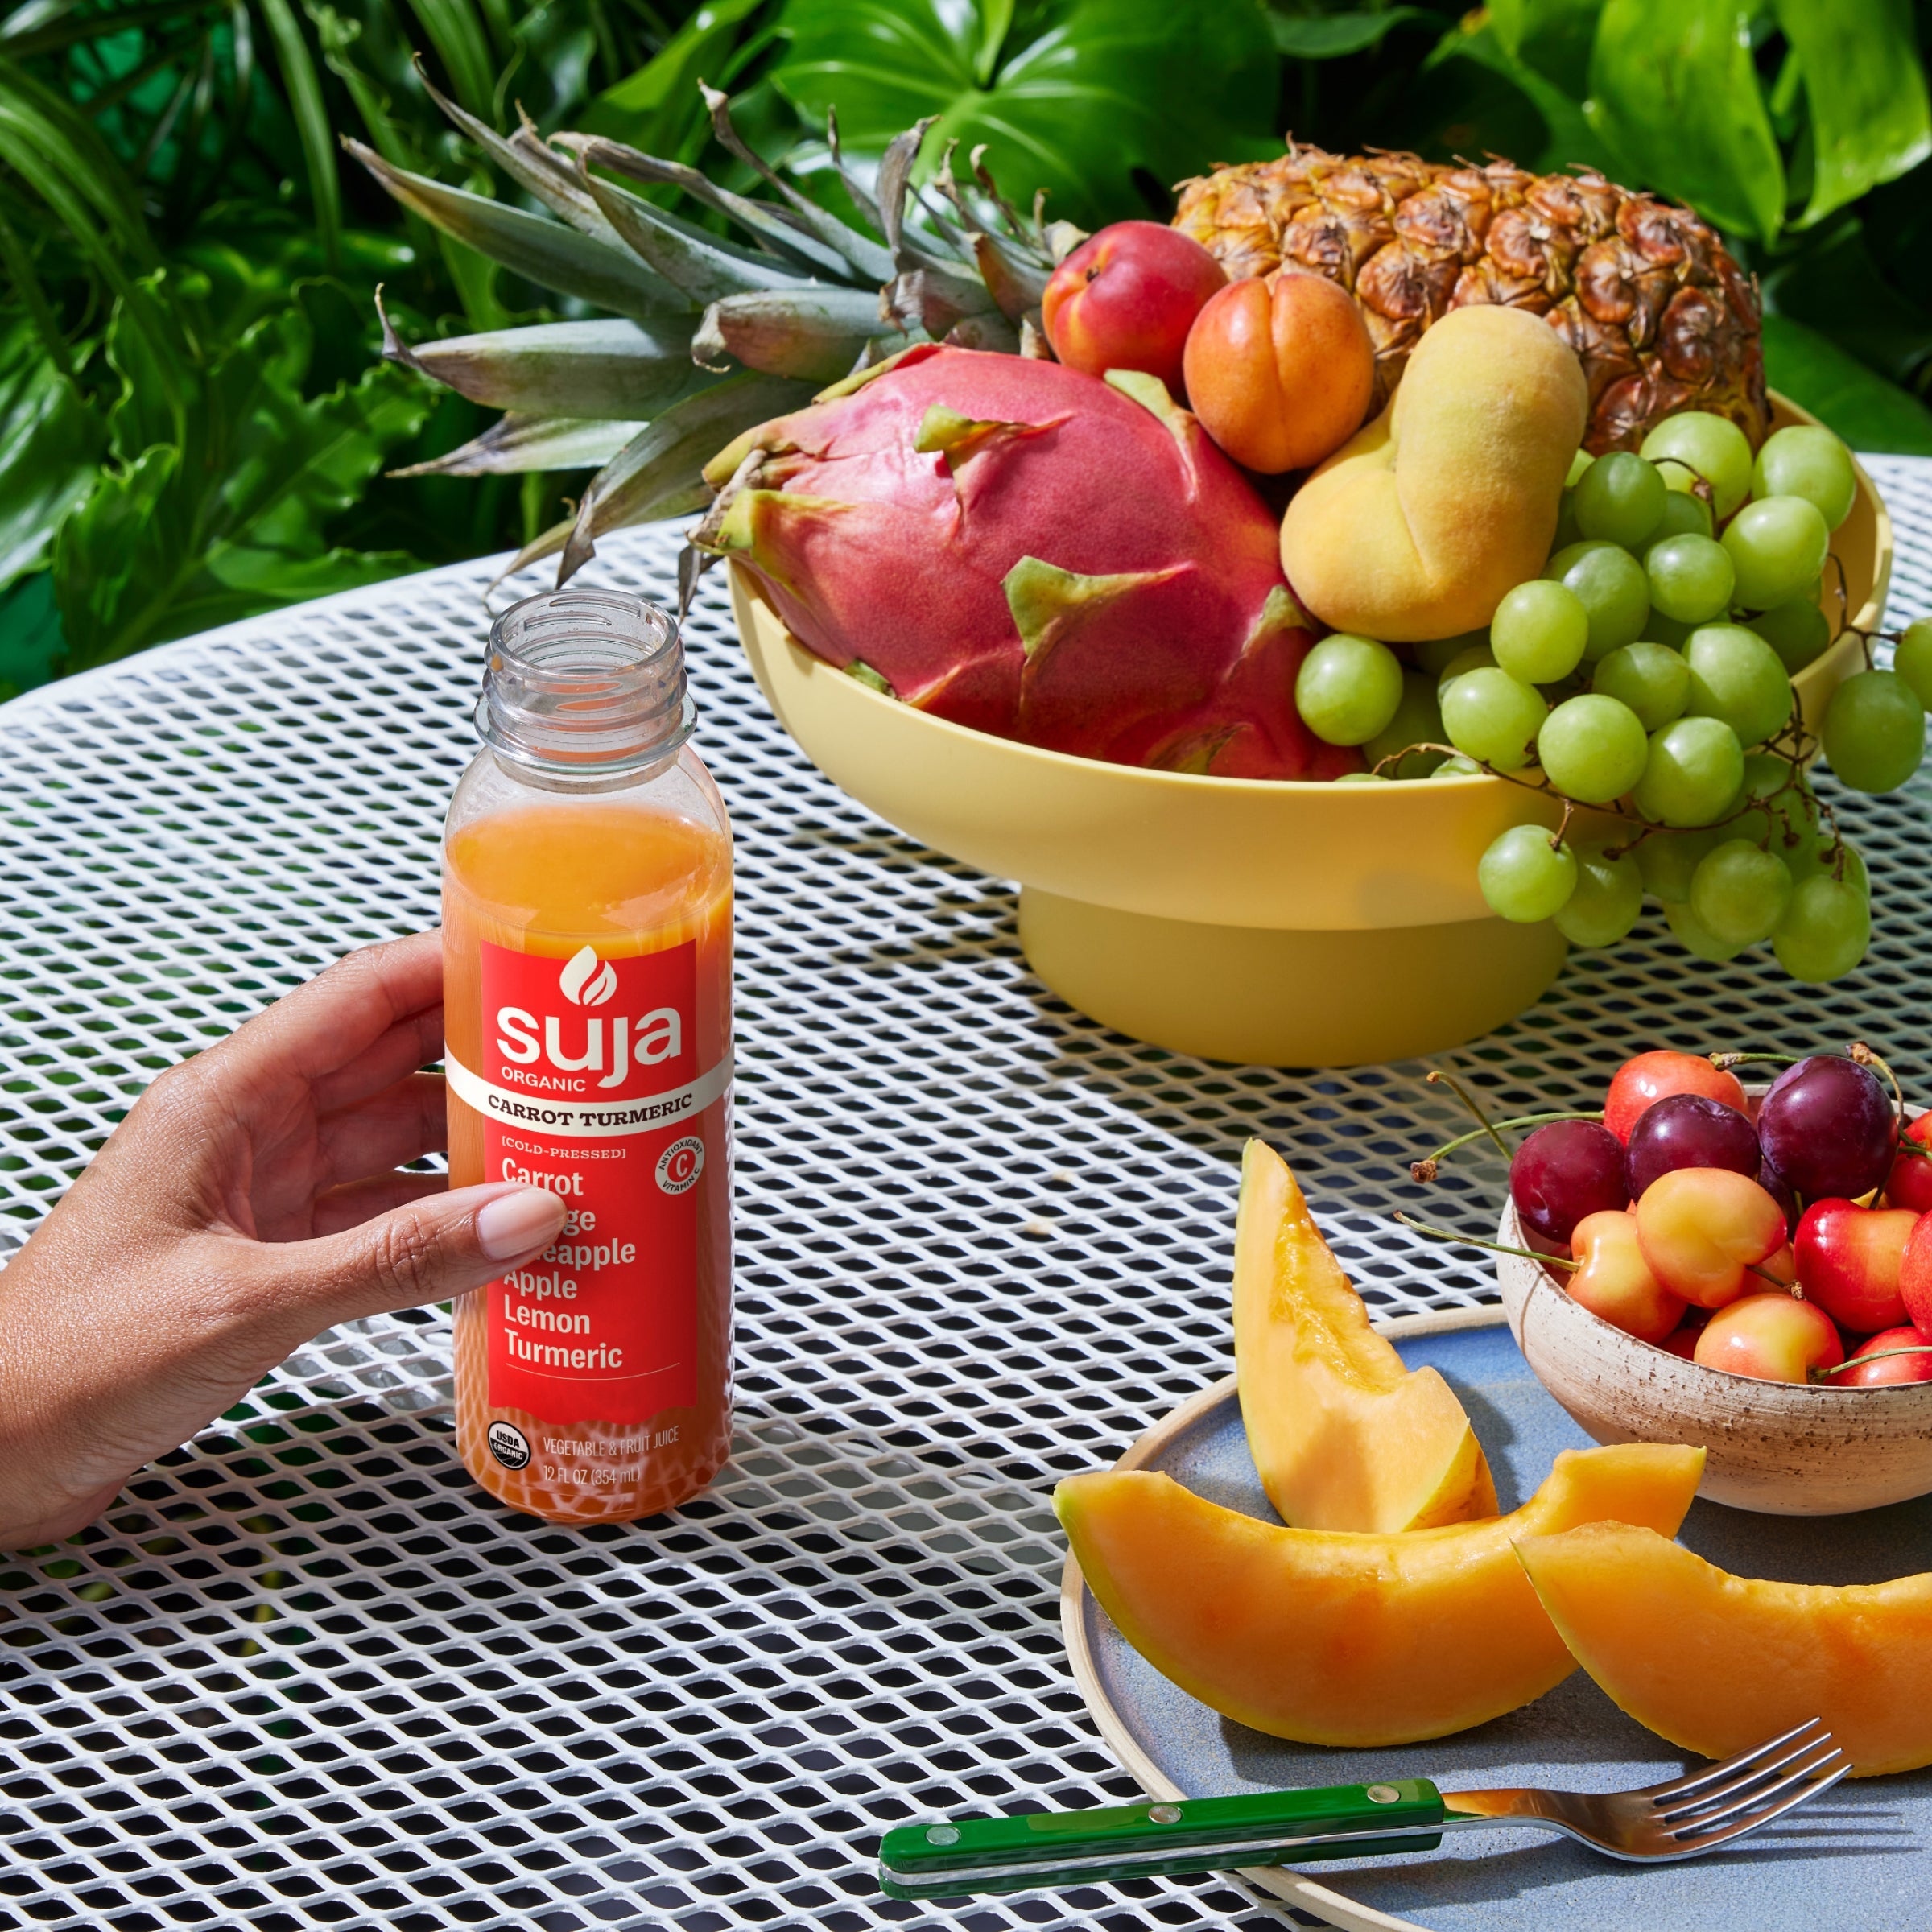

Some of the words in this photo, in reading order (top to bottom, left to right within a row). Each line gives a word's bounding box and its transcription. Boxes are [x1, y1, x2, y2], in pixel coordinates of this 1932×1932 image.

[497, 1006, 681, 1088] suja
[502, 1066, 586, 1092] ORGANIC
[488, 1095, 573, 1126] CARROT
[580, 1093, 692, 1127] TURMERIC
[502, 1136, 626, 1159] [COLD-PRESSED]
[658, 1138, 704, 1170] ANTIOXIDANT
[502, 1158, 584, 1195] Carrot
[676, 1154, 687, 1177] C
[662, 1176, 695, 1193] VITAMIN
[535, 1238, 636, 1271] eapple
[504, 1294, 590, 1334] Lemon
[504, 1329, 622, 1368] Turmeric
[493, 1442, 523, 1460] ORGANIC
[497, 1430, 520, 1447] USDA
[543, 1437, 605, 1456] VEGETABLE
[608, 1443, 617, 1455] &
[619, 1435, 650, 1455] FRUIT
[653, 1426, 679, 1448] JUICE
[543, 1465, 555, 1482] 12
[558, 1468, 570, 1483] FL
[572, 1469, 587, 1484] OZ
[591, 1467, 617, 1484] (354
[619, 1466, 641, 1483] mL)
